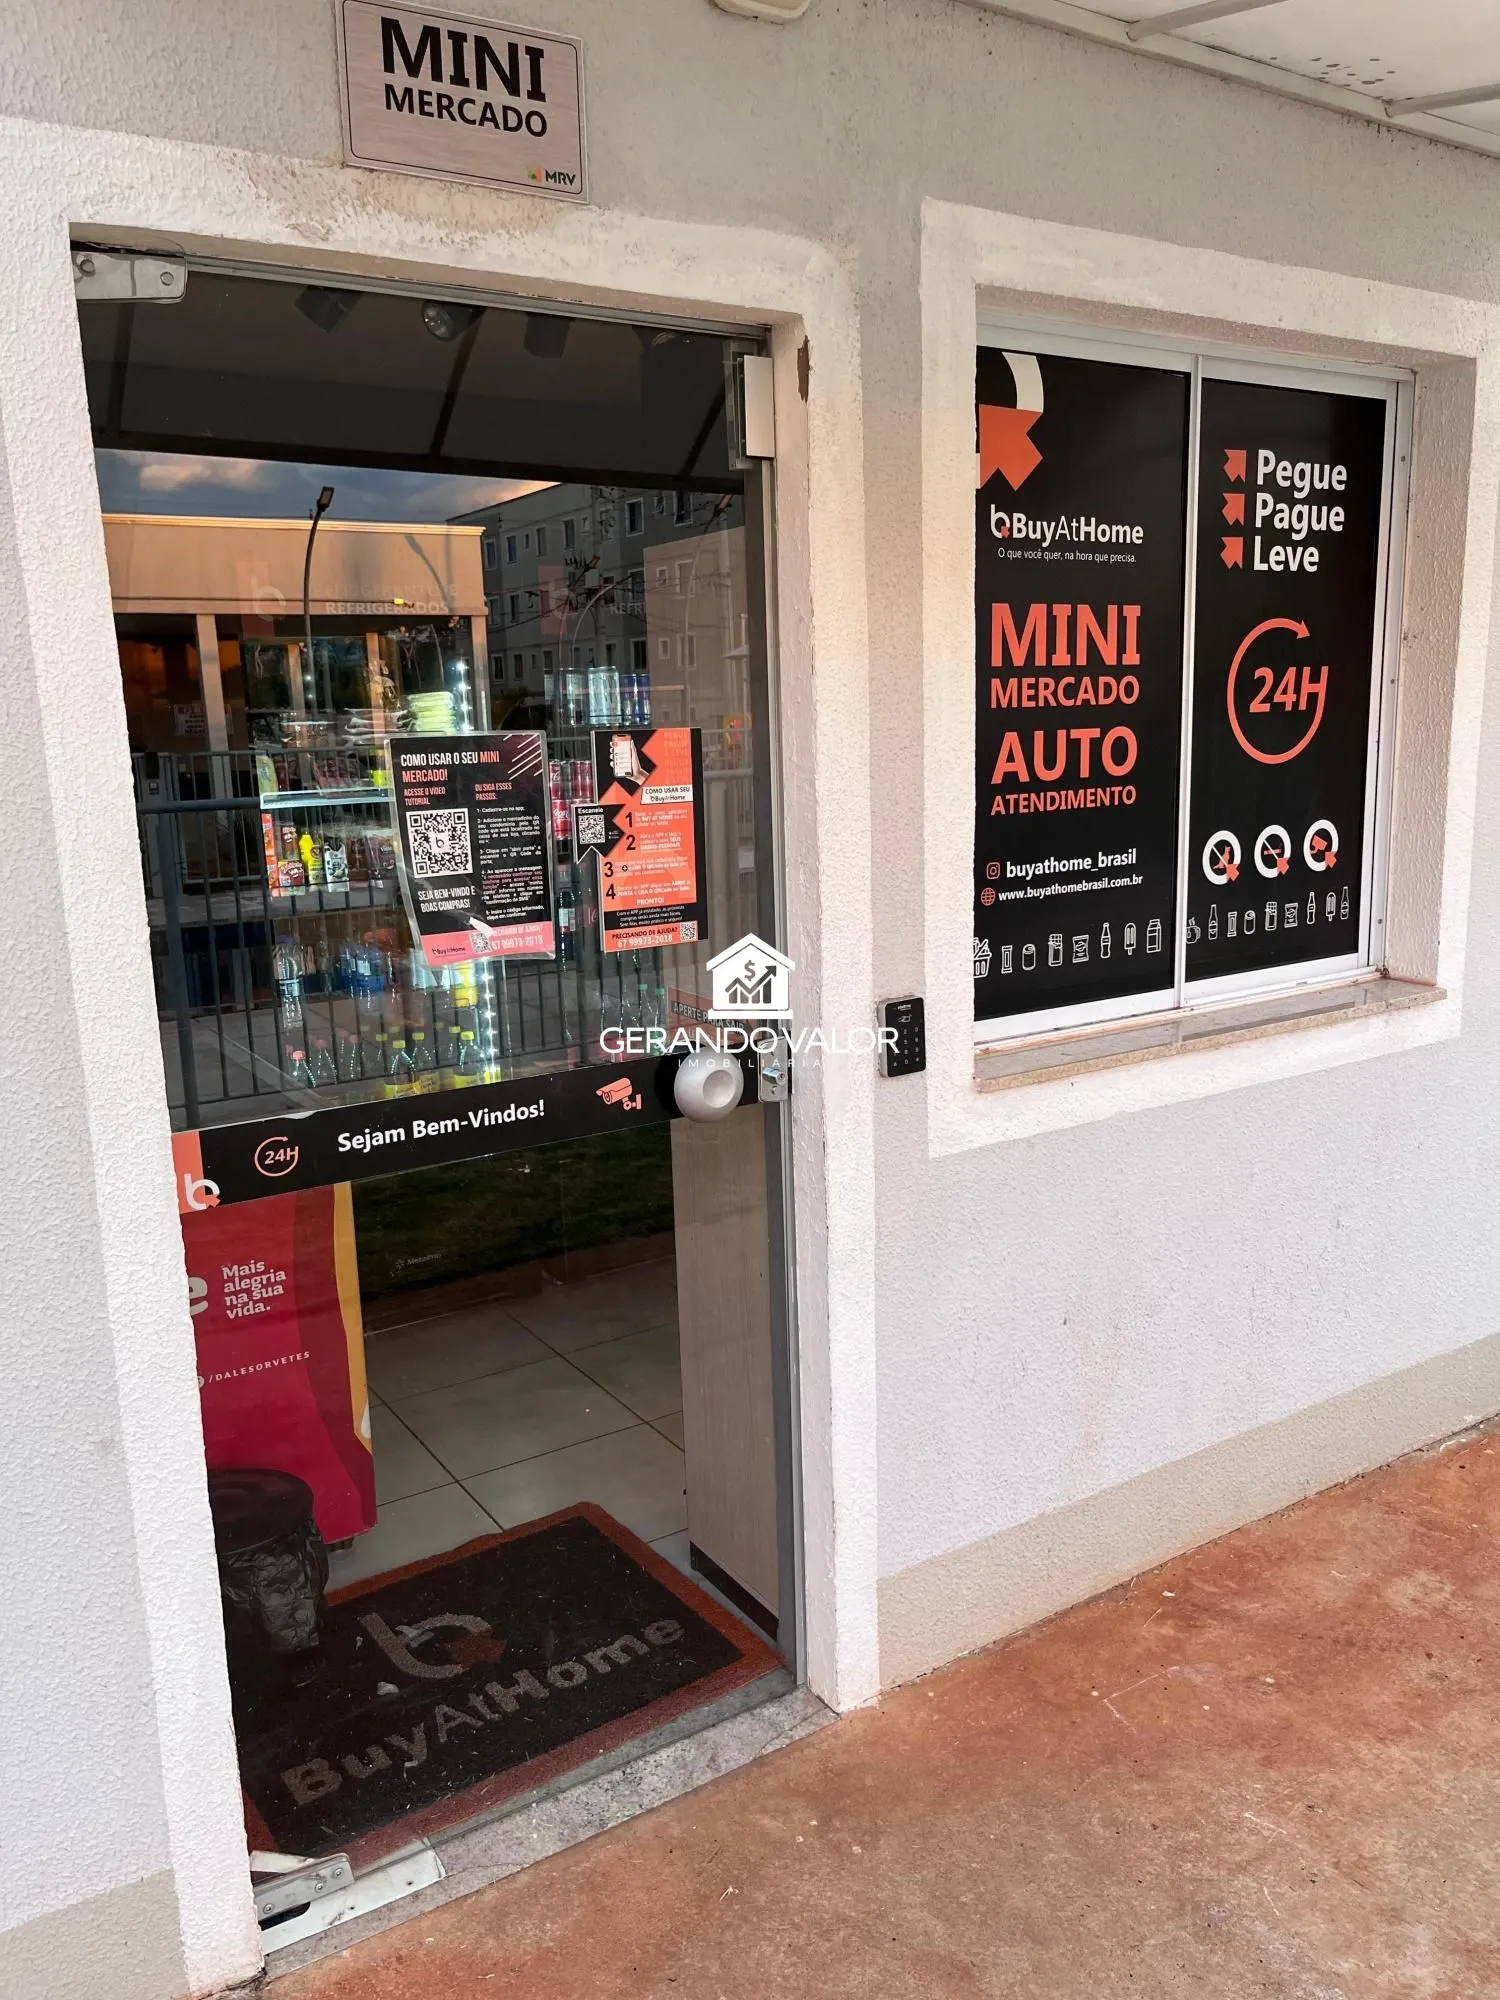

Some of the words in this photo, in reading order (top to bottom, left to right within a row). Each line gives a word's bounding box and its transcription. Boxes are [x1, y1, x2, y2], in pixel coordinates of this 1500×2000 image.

[381, 16, 546, 102] MINI
[384, 83, 547, 137] MERCADO
[545, 169, 576, 186] MRV
[1257, 449, 1347, 499] Pegue
[1255, 492, 1345, 541] Pague
[998, 548, 1005, 558] O
[1007, 550, 1022, 561] que
[1024, 549, 1042, 559] você
[1044, 551, 1063, 562] quer,
[1065, 552, 1074, 560] na
[1076, 550, 1093, 561] hora
[1095, 552, 1109, 563] que
[1110, 552, 1137, 563] precisa.
[1253, 535, 1319, 572] Leve
[991, 603, 1141, 667] MINI
[990, 675, 1140, 708] MERCADO
[1249, 666, 1329, 713] 24H
[401, 754, 427, 767] COMO
[429, 753, 452, 766] USAR
[453, 752, 460, 765] O
[461, 751, 478, 765] SEU
[479, 750, 500, 763] MINI
[990, 725, 1138, 784] AUTO
[402, 769, 448, 783] MERCADO!
[404, 788, 424, 796] ACESSE
[425, 788, 430, 796] O
[430, 786, 446, 796] VÍDEO
[483, 783, 495, 791] SIGA
[495, 782, 512, 791] ESSES
[990, 785, 1137, 816] ATENDIMENTO
[625, 812, 633, 828] 1
[626, 835, 636, 851] 2
[604, 861, 614, 878] 3
[1006, 847, 1137, 880] buyathome_brasil
[418, 889, 434, 901] SEJA
[435, 886, 470, 900] BEM-VINDO
[470, 886, 476, 895] E
[606, 883, 616, 900] 4
[998, 874, 1143, 901] www.buyathomebrasil.com.br
[421, 901, 438, 913] BOAS
[439, 899, 471, 911] COMPRAS!
[612, 931, 648, 940] PRECISANDO
[656, 927, 678, 935] AJUDA?
[617, 939, 627, 948] 67
[629, 934, 673, 946] 99973-2018
[673, 1001, 702, 1021] APERTE
[337, 1128, 406, 1153] Sejam
[412, 1099, 545, 1138] Bem-Vindos!
[264, 1146, 299, 1165] 24H
[221, 1260, 265, 1279] Mais
[223, 1269, 287, 1293] alegria
[224, 1290, 249, 1306] na
[252, 1284, 284, 1300] sua
[226, 1302, 271, 1319] vida.
[208, 1351, 311, 1383] /DALESORVETES
[279, 1618, 686, 1805] BuyAtHome
